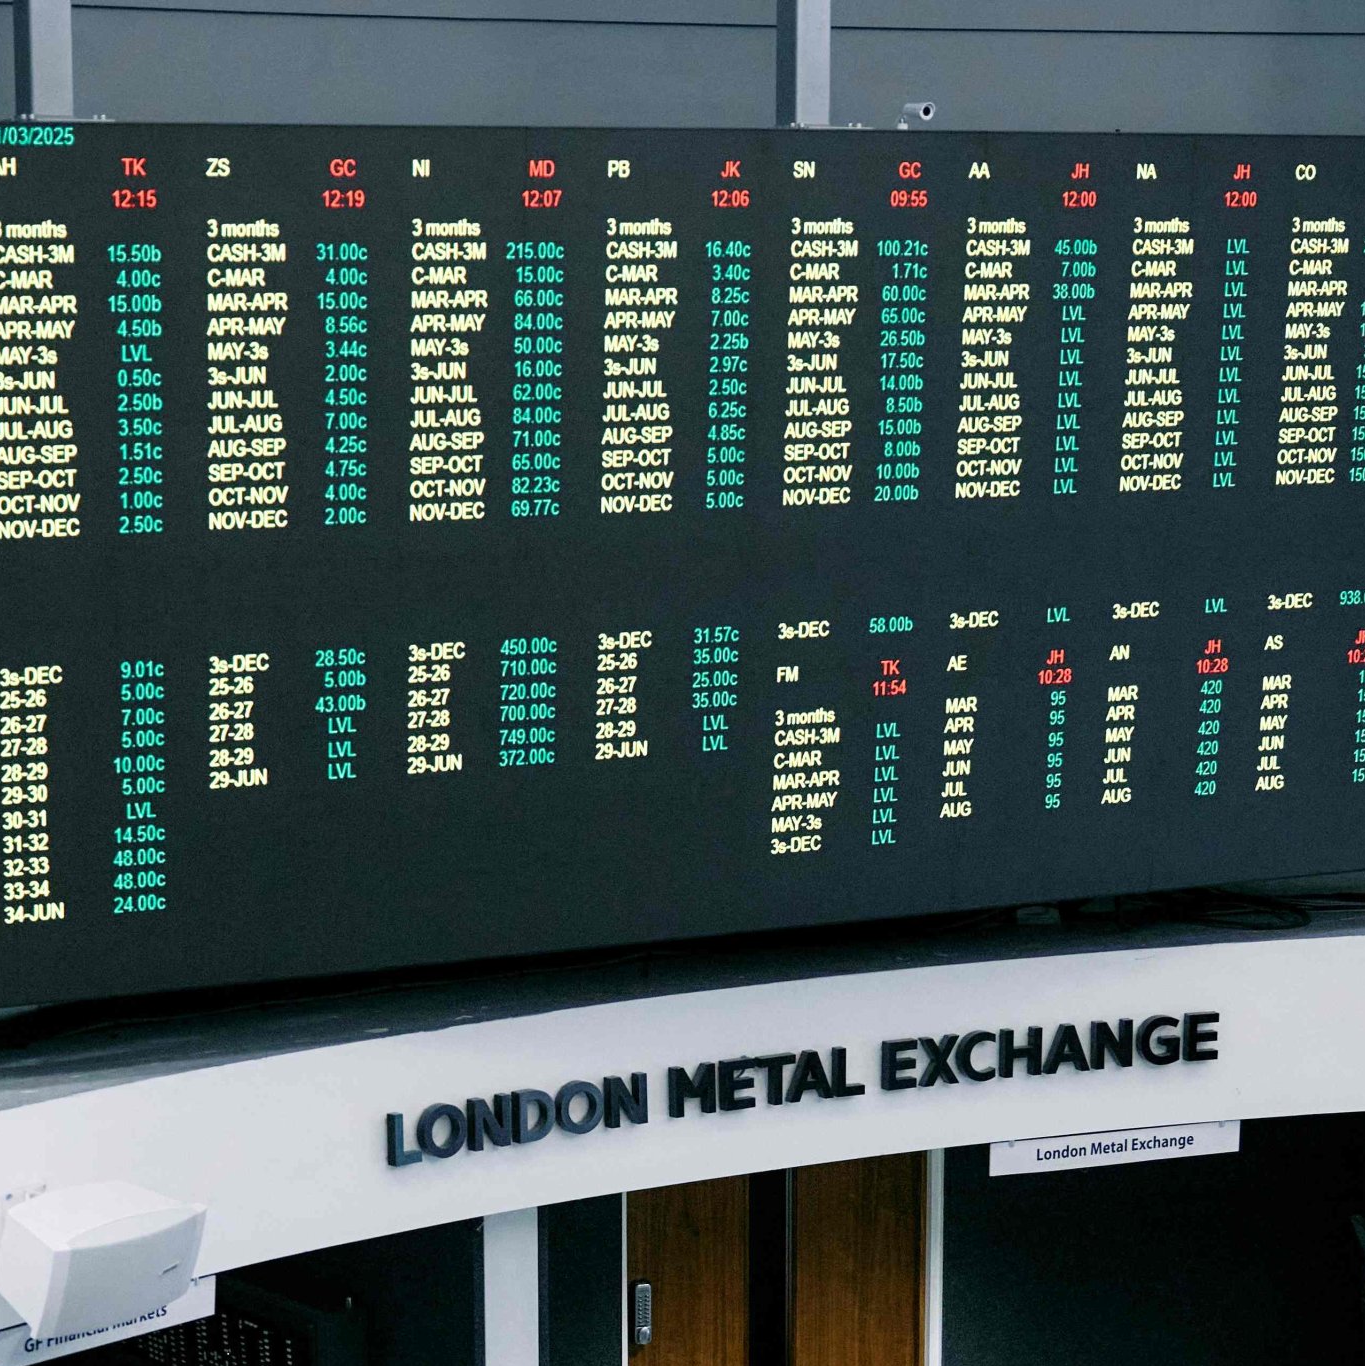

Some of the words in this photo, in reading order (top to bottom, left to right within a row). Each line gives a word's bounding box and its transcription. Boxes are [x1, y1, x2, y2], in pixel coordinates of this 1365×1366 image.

[121, 158, 146, 176] TK
[206, 158, 230, 177] ZS
[330, 159, 356, 177] GC
[412, 159, 430, 177] NI
[529, 160, 555, 178] MD
[608, 160, 630, 178] PB
[721, 161, 740, 178] JK
[793, 161, 815, 178] SN
[899, 162, 921, 179] GC
[968, 162, 990, 179] AA
[1071, 163, 1089, 179] JH
[1137, 163, 1157, 179] NA
[1233, 164, 1250, 180] JH
[1295, 164, 1316, 180] CO
[112, 189, 157, 208] 12:15
[322, 190, 365, 208] 12:19
[522, 190, 562, 208] 12:07
[712, 190, 749, 208] 12:06
[890, 190, 927, 207] 09:55
[1063, 191, 1097, 208] 12:00
[1225, 191, 1257, 207] 12:00
[777, 666, 799, 683] FM
[881, 660, 900, 675] TK
[873, 679, 906, 696] 11:54
[386, 1073, 649, 1166] LONDON
[668, 1045, 865, 1118] METAL
[880, 1010, 1220, 1091] EXCHANGE
[1036, 1145, 1087, 1161] London
[1090, 1139, 1128, 1155] Metal
[1131, 1135, 1194, 1151] Exchange
